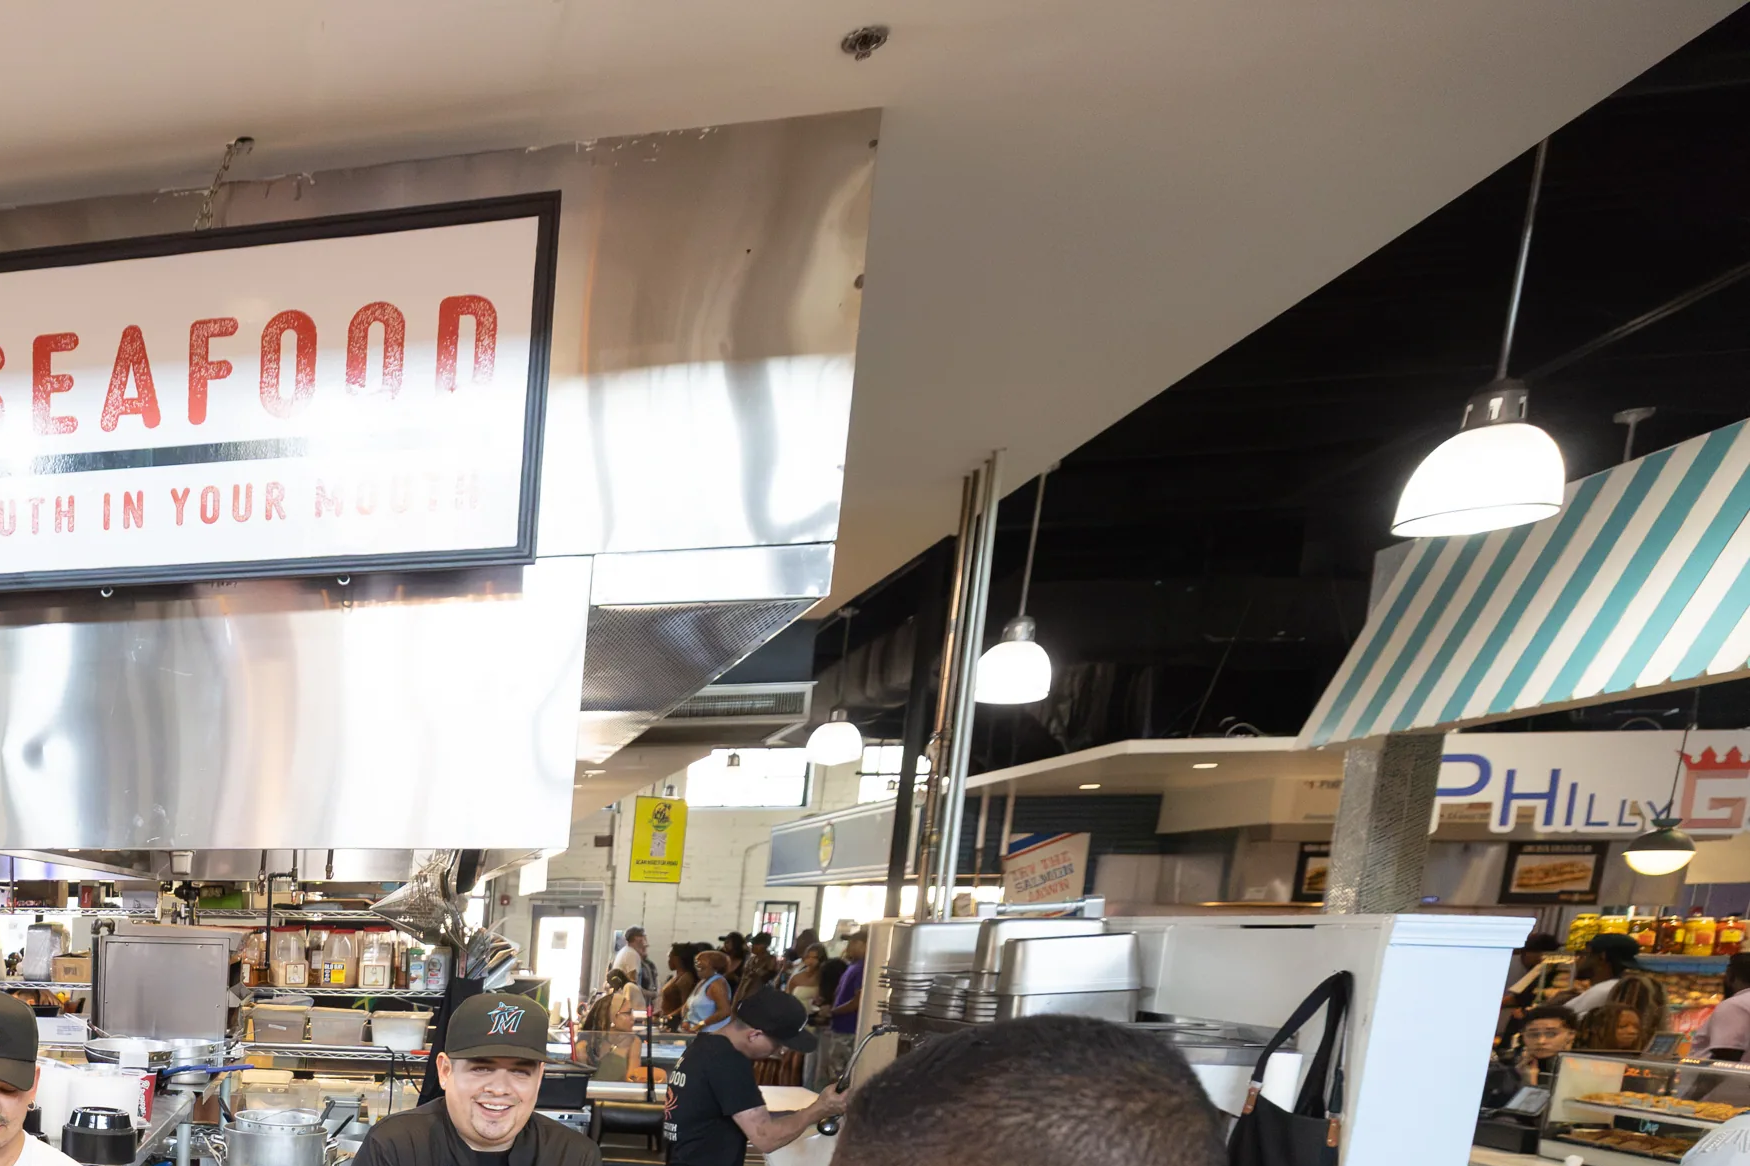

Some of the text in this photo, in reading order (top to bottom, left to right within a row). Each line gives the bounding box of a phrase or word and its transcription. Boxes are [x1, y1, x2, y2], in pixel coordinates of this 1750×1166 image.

[103, 490, 144, 530] IN
[171, 481, 286, 526] YOUR
[1435, 753, 1674, 827] PHILLY
